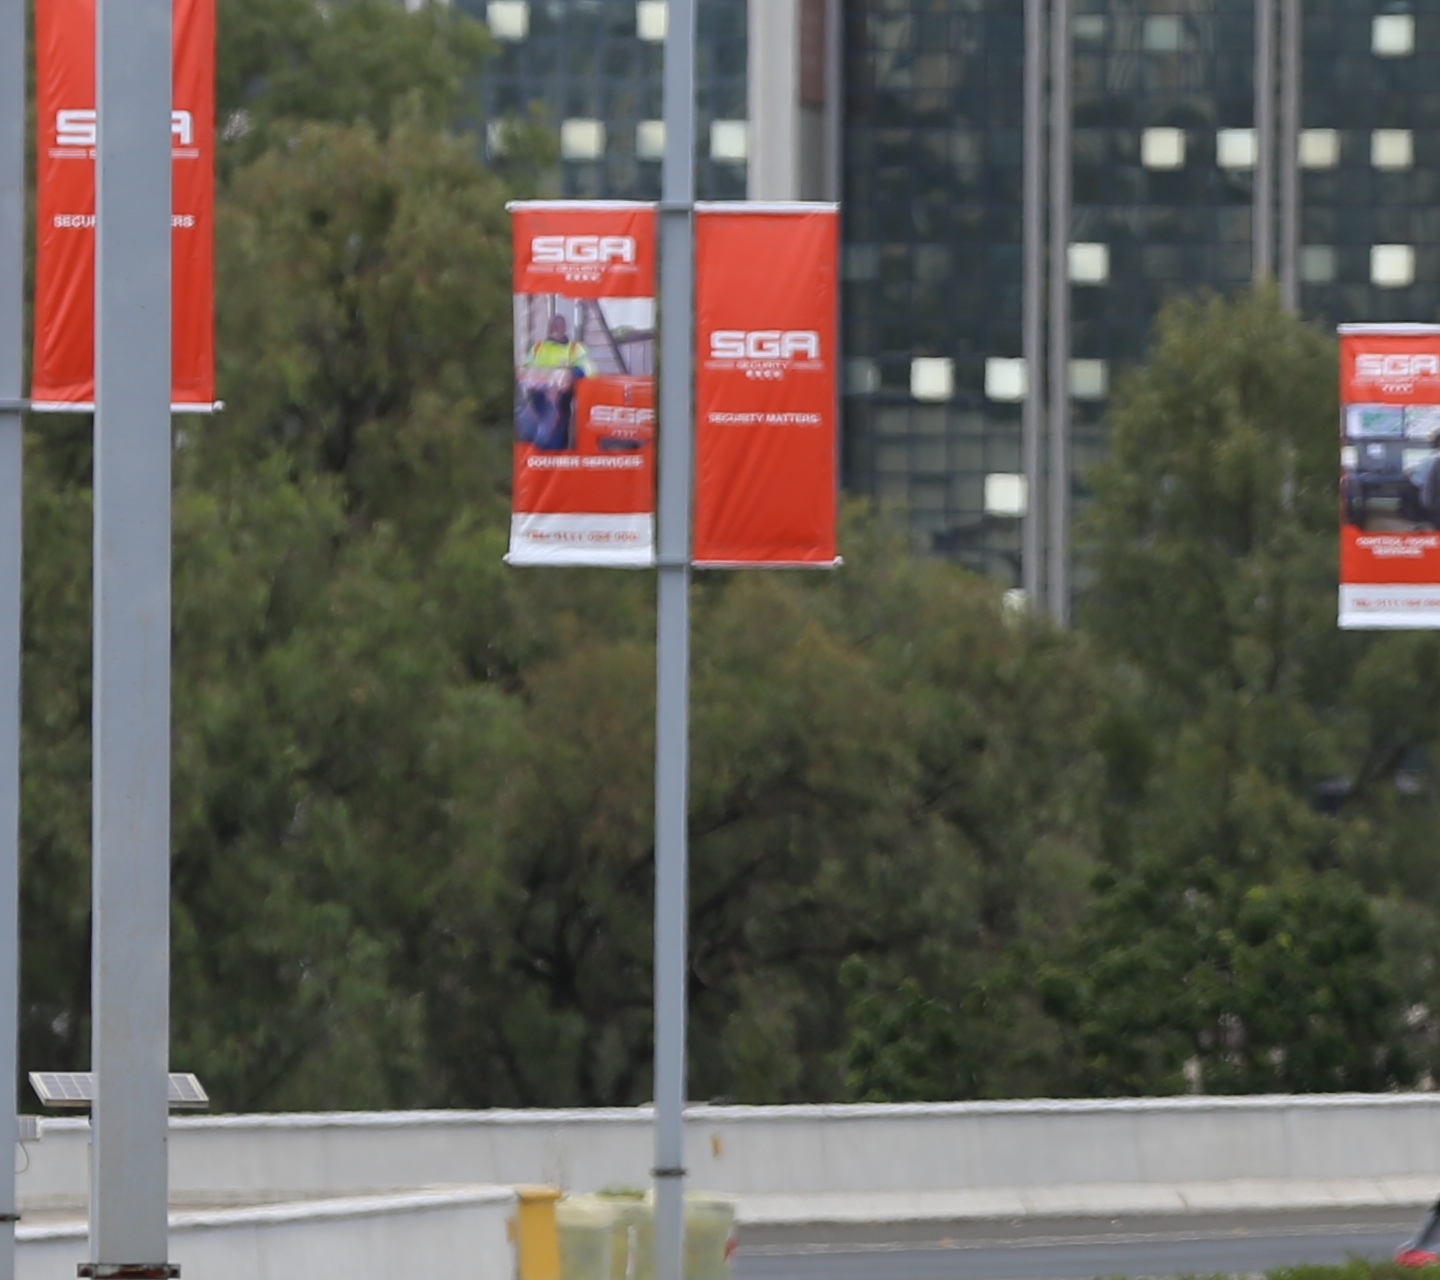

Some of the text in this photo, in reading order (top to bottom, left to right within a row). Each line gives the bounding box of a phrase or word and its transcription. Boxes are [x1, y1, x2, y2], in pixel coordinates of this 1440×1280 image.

[531, 236, 635, 263] SGA
[710, 330, 820, 359] SGA
[1355, 353, 1440, 376] SGA
[708, 412, 821, 424] SECURITY MATTERS
